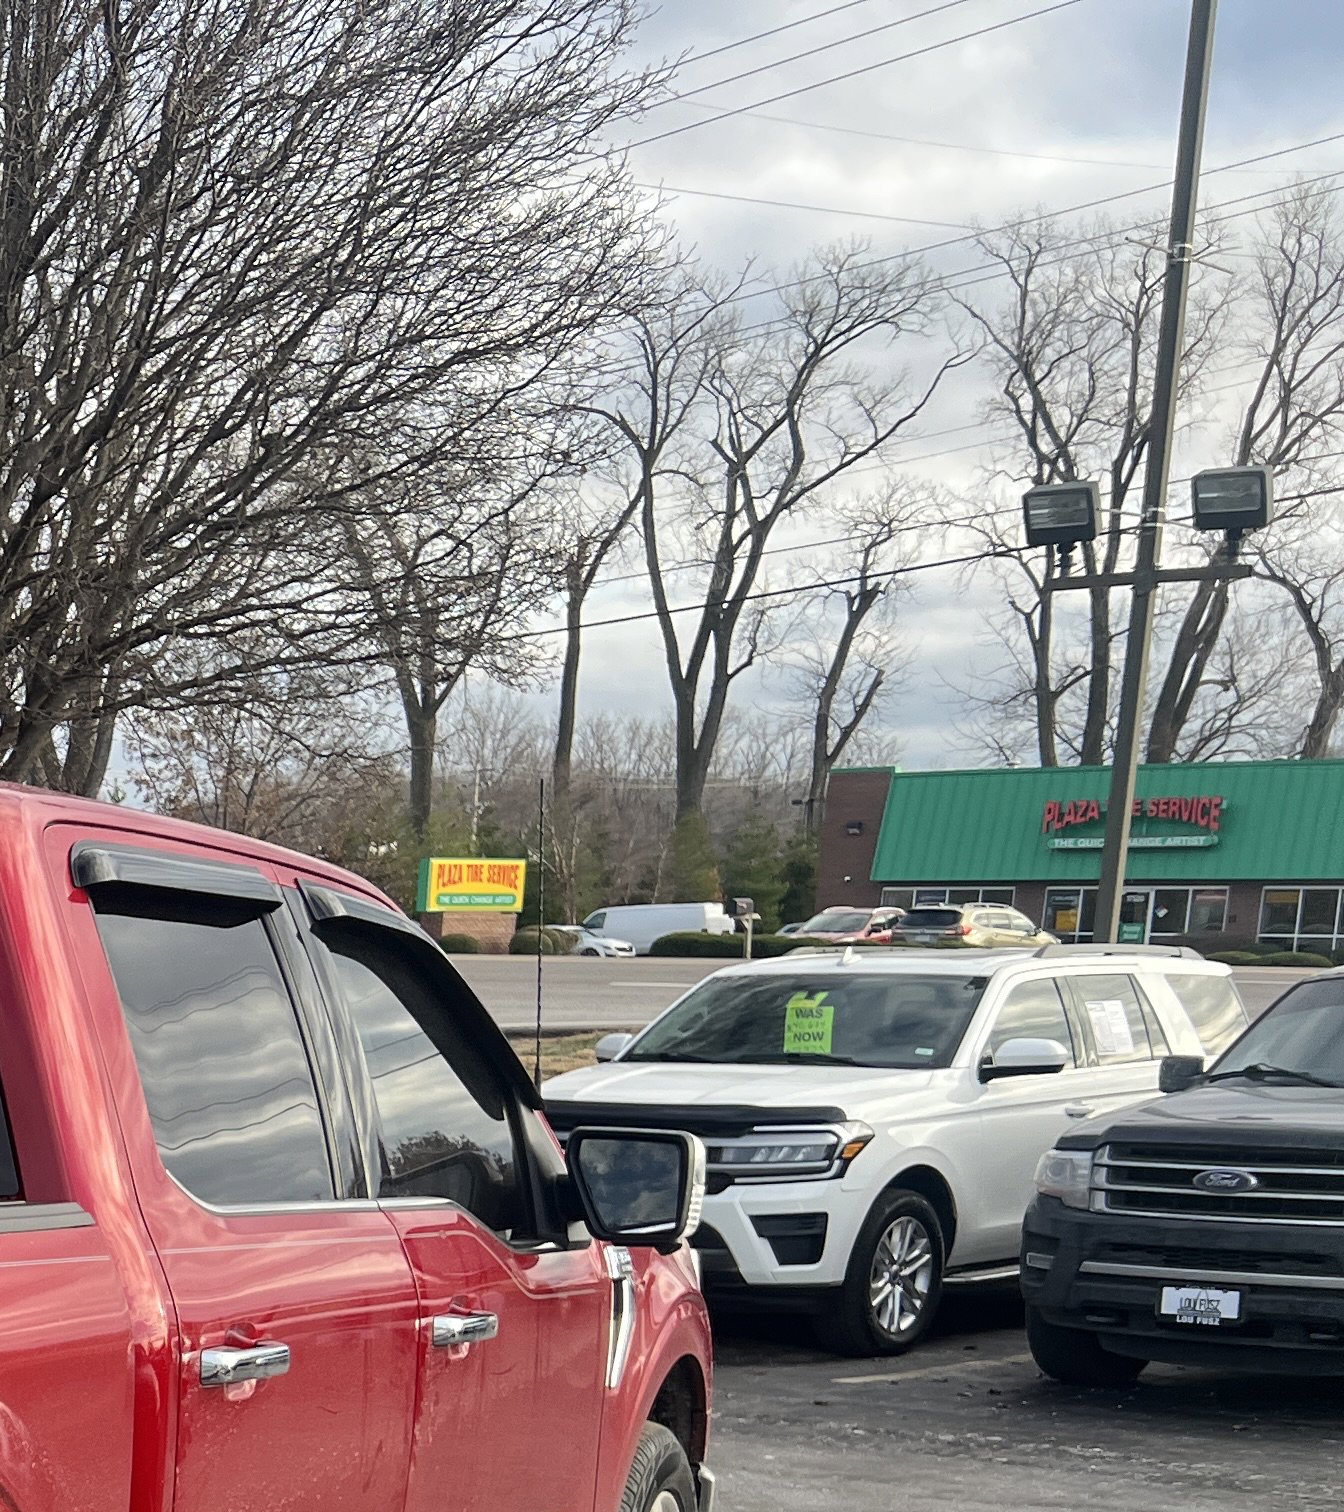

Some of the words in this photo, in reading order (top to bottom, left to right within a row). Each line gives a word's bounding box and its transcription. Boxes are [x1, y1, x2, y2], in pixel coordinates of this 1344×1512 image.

[1043, 800, 1100, 834] PLAZA
[1147, 795, 1225, 832] SERVICE
[1054, 838, 1074, 848] THE
[1077, 838, 1105, 849] QUIC
[1166, 835, 1206, 846] ARTIST
[436, 863, 463, 890] PLAZA
[466, 863, 484, 883] TIRE
[486, 863, 520, 890] SERVICE
[795, 1008, 823, 1019] WAS
[793, 1031, 824, 1042] NOW
